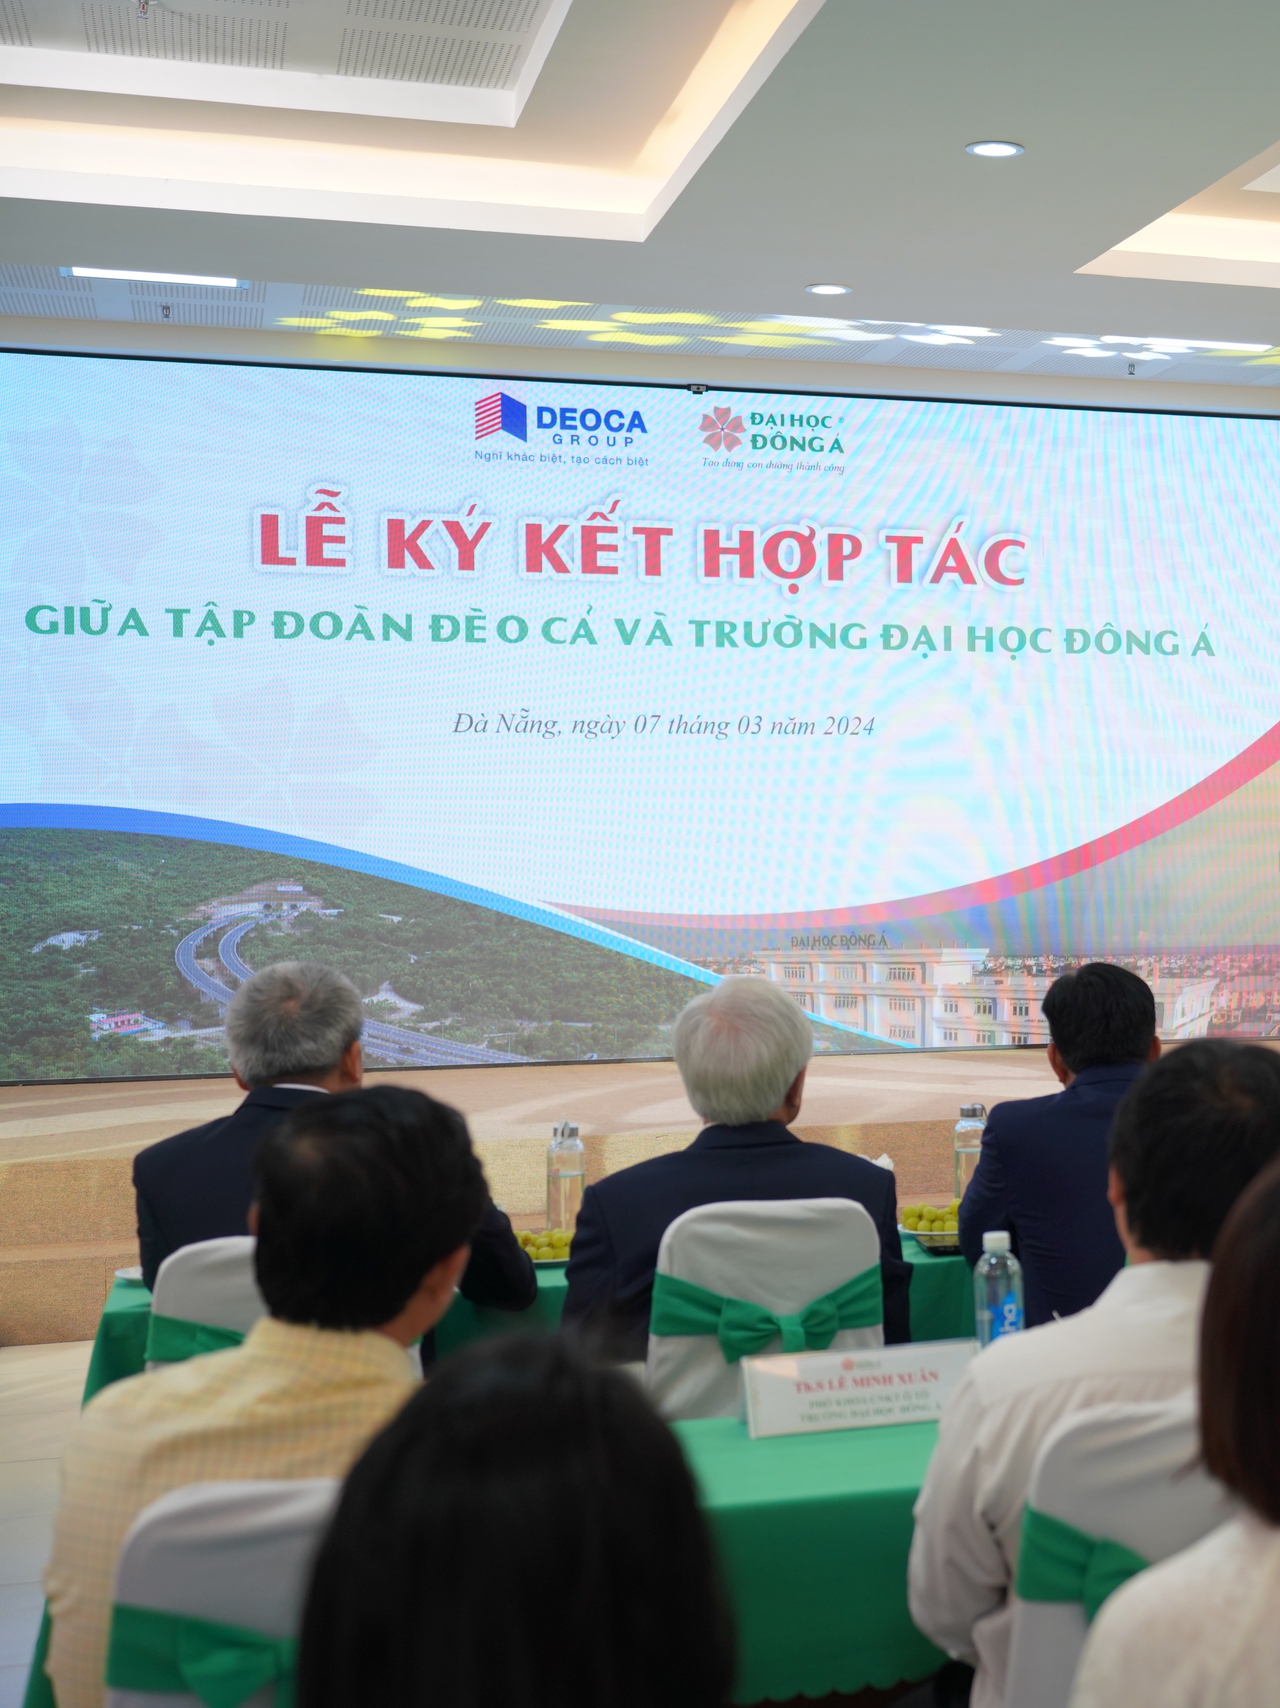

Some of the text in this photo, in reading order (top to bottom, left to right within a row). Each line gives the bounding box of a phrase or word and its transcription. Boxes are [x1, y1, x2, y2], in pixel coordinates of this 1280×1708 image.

[537, 406, 649, 434] DEOCA
[750, 412, 832, 432] ĐẠI HỌC
[553, 434, 634, 448] GROUP
[750, 432, 845, 454] ĐÔNG Á
[507, 451, 536, 463] khác
[540, 452, 568, 465] biệt,
[571, 454, 590, 467] tạo
[594, 453, 622, 466] cách
[626, 454, 650, 467] biệt
[702, 457, 720, 469] Tạo
[796, 460, 820, 471] thành
[824, 463, 845, 475] công
[260, 488, 1027, 595] LỄ KÝ KẾT HỢP TÁC
[25, 598, 1216, 660] GIỮA TẬP ĐOÀN ĐÈO CẢ VÀ TRƯỜNG ĐẠI HỌC ĐÔNG Á
[452, 708, 877, 740] Đà Nẵng, ngày 07 tháng 03 năm 2024
[852, 1373, 894, 1388] MINH
